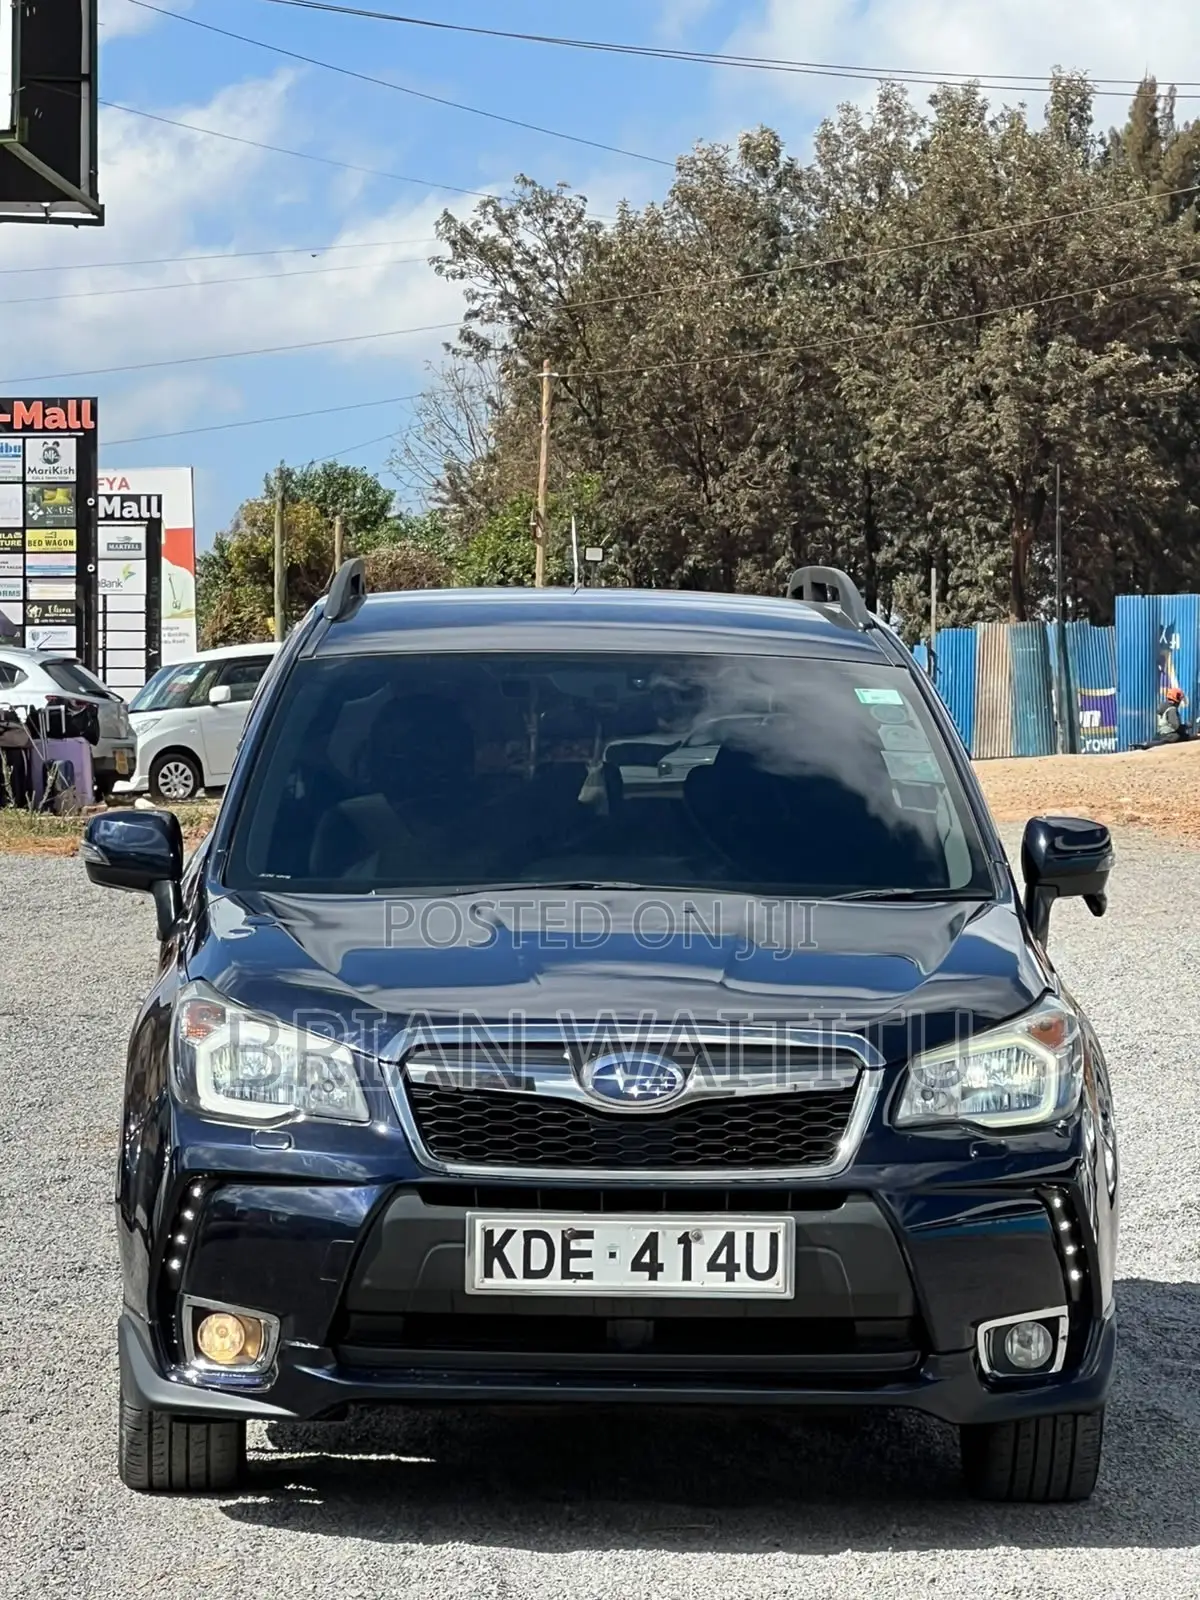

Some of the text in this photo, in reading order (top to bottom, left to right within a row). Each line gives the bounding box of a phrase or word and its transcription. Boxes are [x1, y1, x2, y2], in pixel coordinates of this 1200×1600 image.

[27, 466, 75, 475] MariKish
[98, 495, 161, 518] Mall
[45, 539, 74, 547] WAGON
[98, 579, 124, 588] Bank
[483, 1228, 780, 1282] KDE 414U
